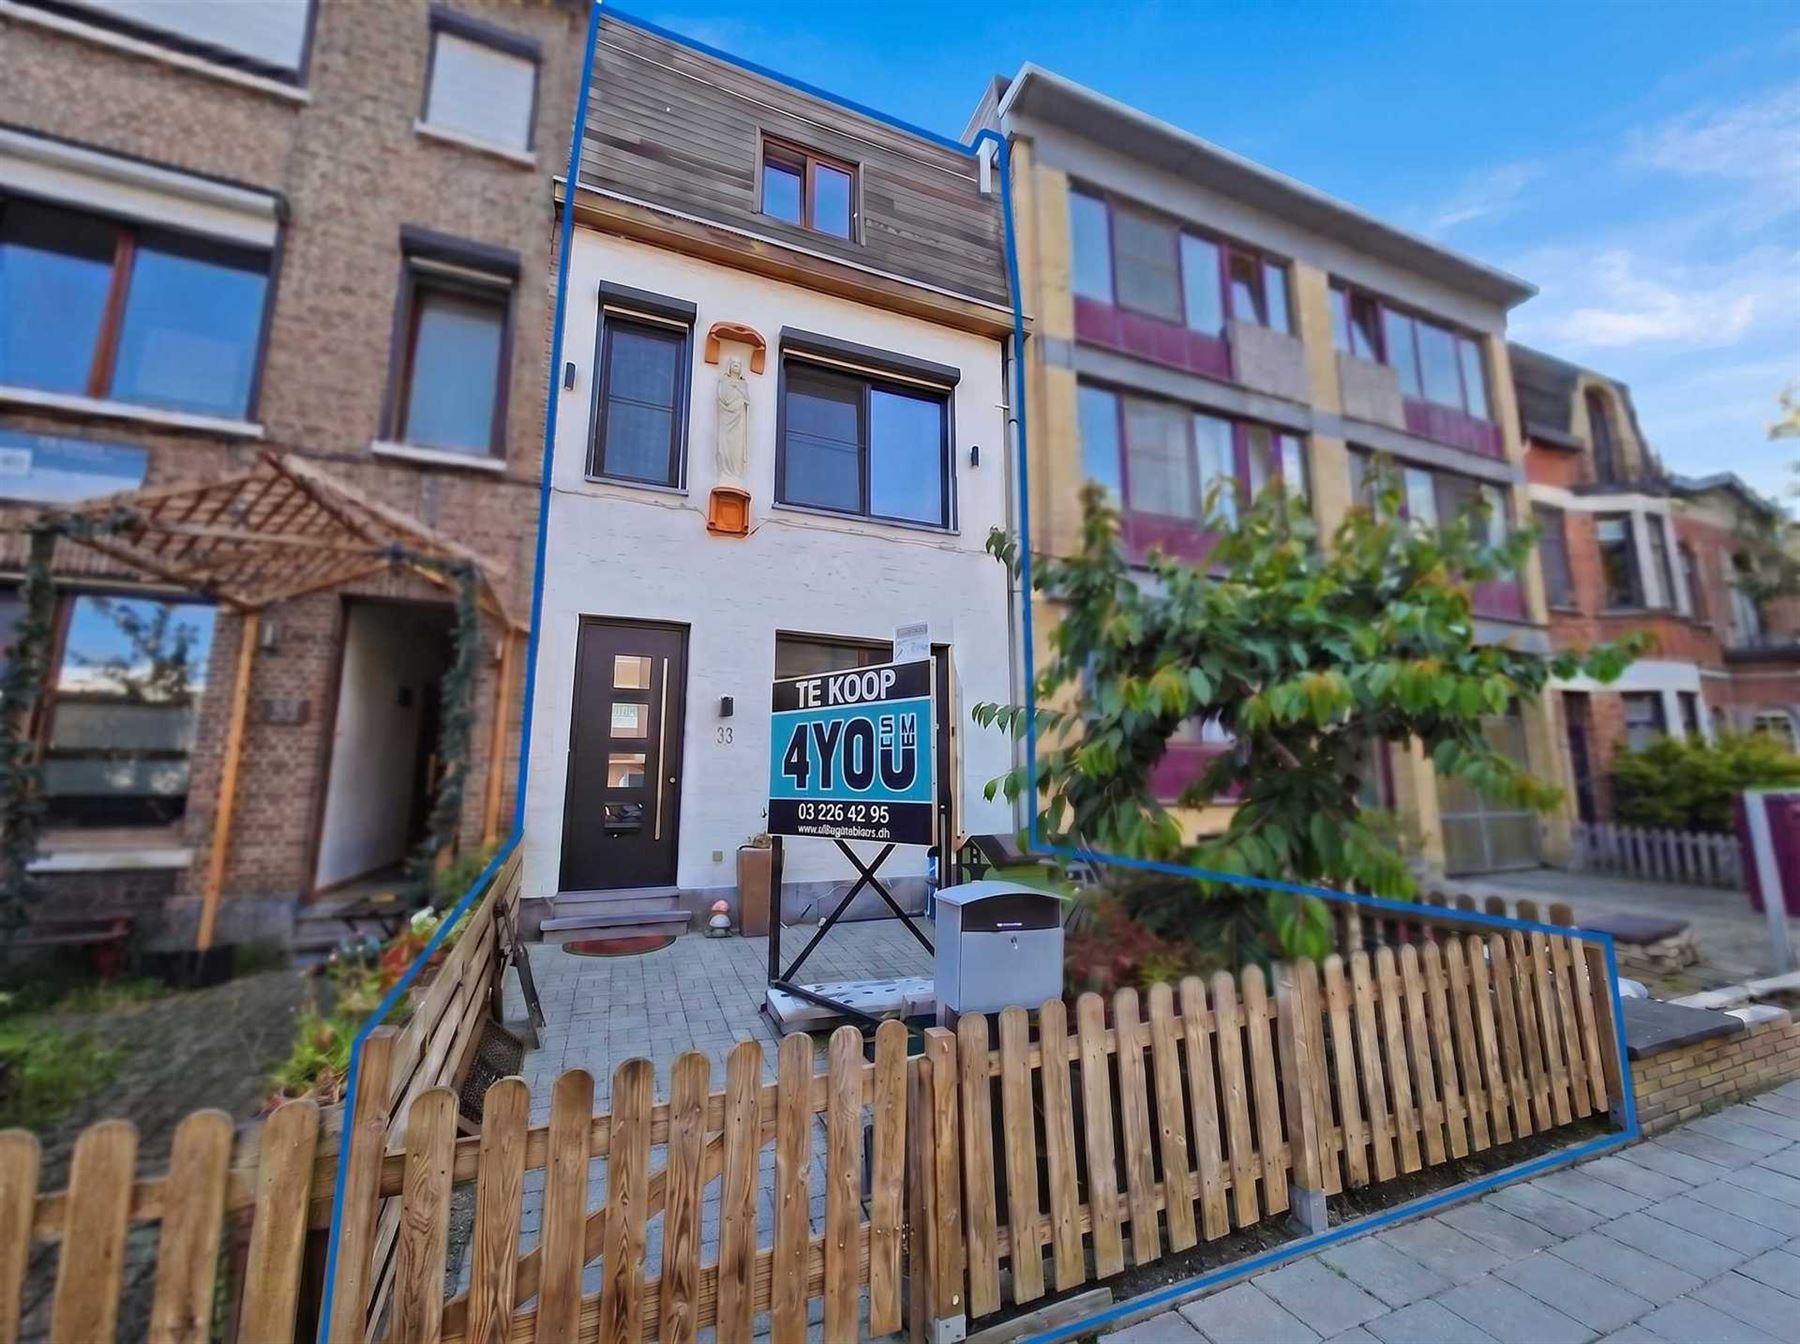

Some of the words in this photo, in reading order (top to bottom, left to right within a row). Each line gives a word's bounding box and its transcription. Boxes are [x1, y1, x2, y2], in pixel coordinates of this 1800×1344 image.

[796, 679, 821, 708] TE
[828, 669, 896, 705] KOOP
[717, 727, 733, 744] 33
[798, 803, 815, 820] 03
[818, 804, 844, 821] 226
[847, 805, 866, 822] 42
[869, 805, 890, 823] 95
